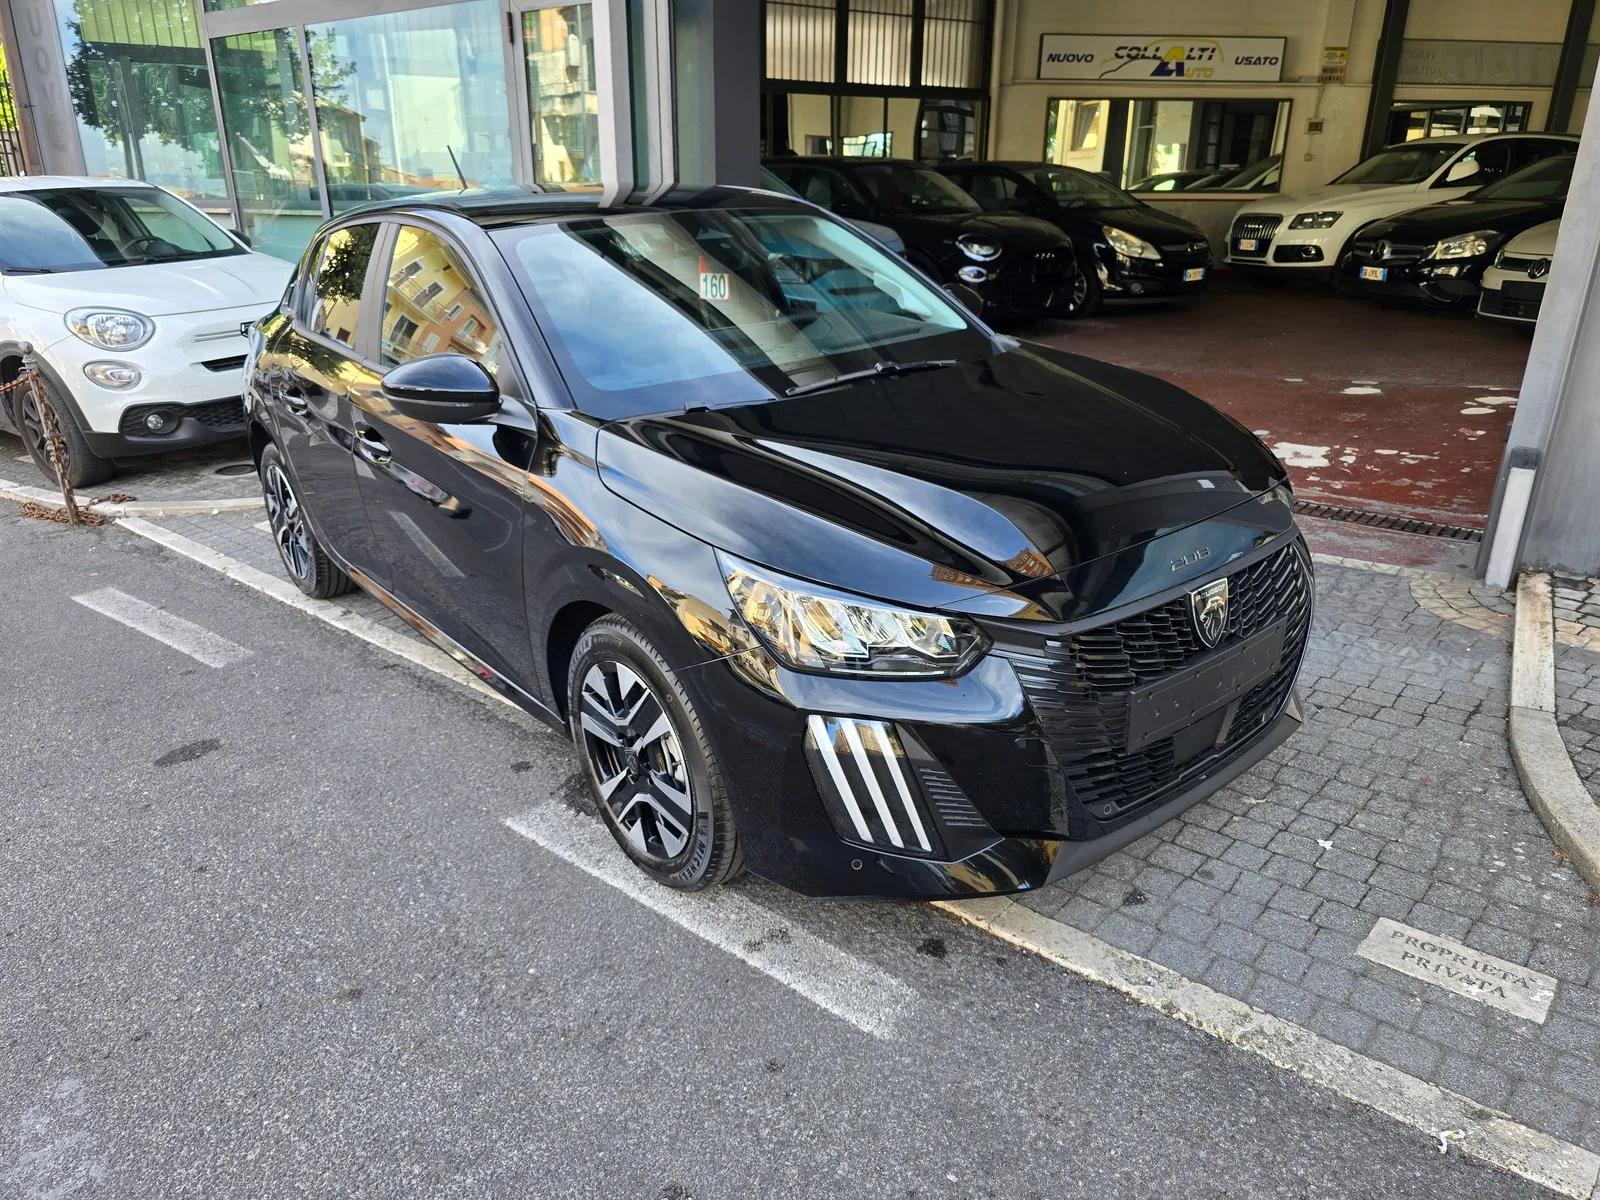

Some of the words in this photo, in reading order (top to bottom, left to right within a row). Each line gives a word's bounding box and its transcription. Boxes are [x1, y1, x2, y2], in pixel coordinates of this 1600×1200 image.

[1047, 53, 1094, 63] NUOVO
[1234, 56, 1279, 66] USATO
[702, 273, 726, 299] 160
[1171, 547, 1211, 571] 208
[1195, 583, 1226, 602] PEUGEOT
[1401, 951, 1506, 999] PRIVATA
